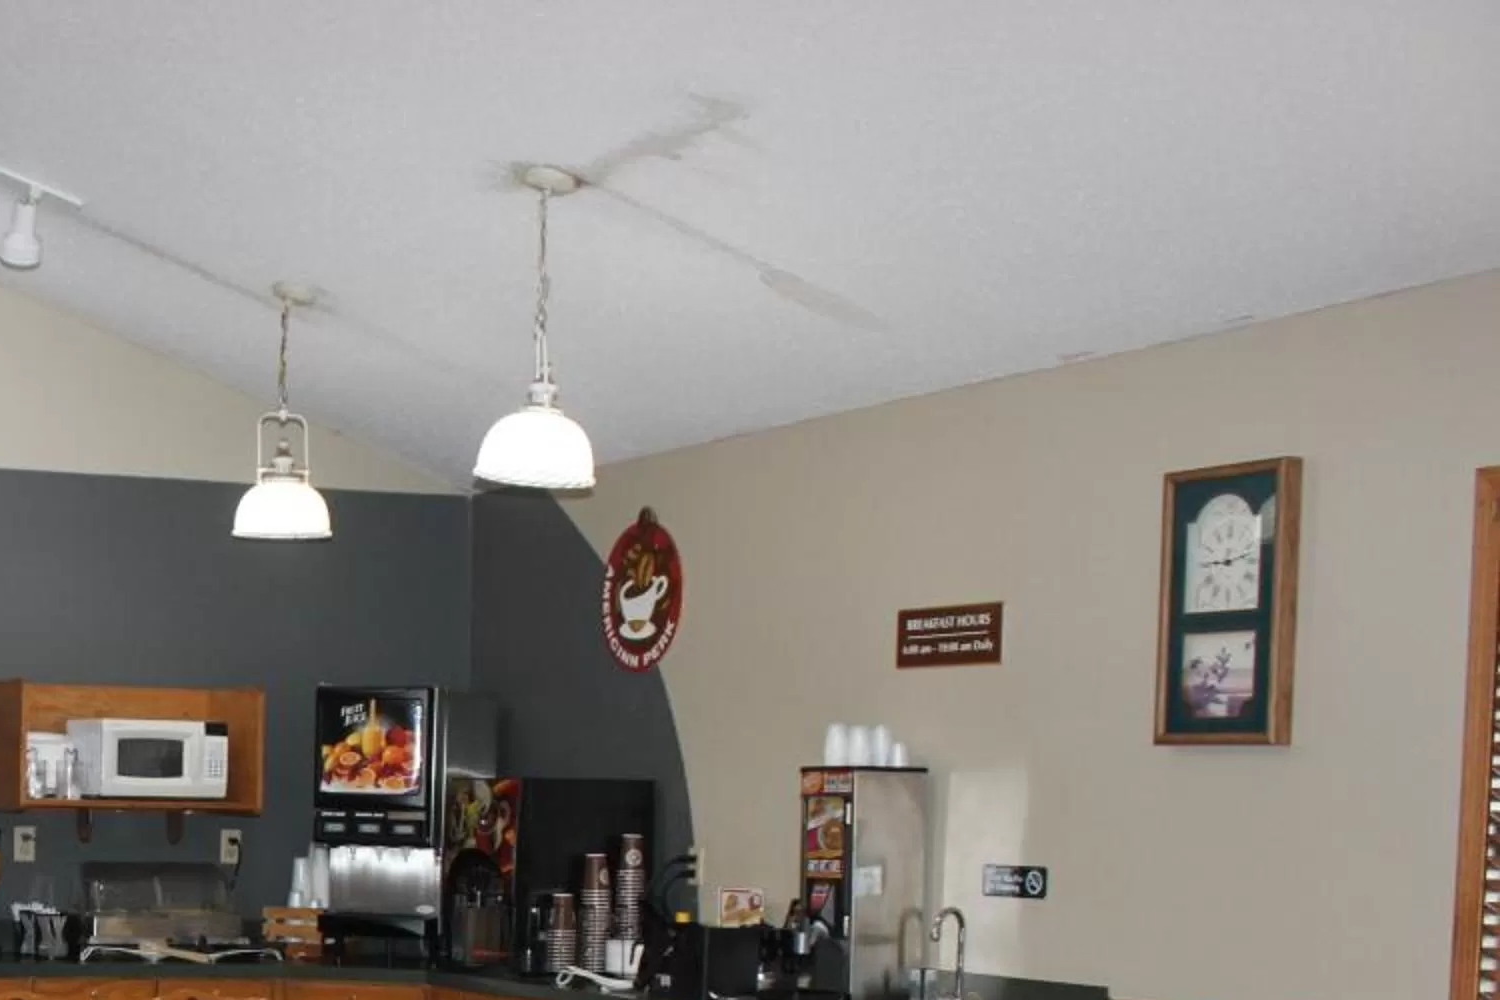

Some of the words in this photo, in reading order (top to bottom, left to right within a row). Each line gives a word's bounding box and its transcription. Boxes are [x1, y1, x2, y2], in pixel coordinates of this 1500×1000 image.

[602, 564, 639, 668] AMERICINN
[642, 619, 675, 667] PERK
[956, 613, 992, 627] HOURS
